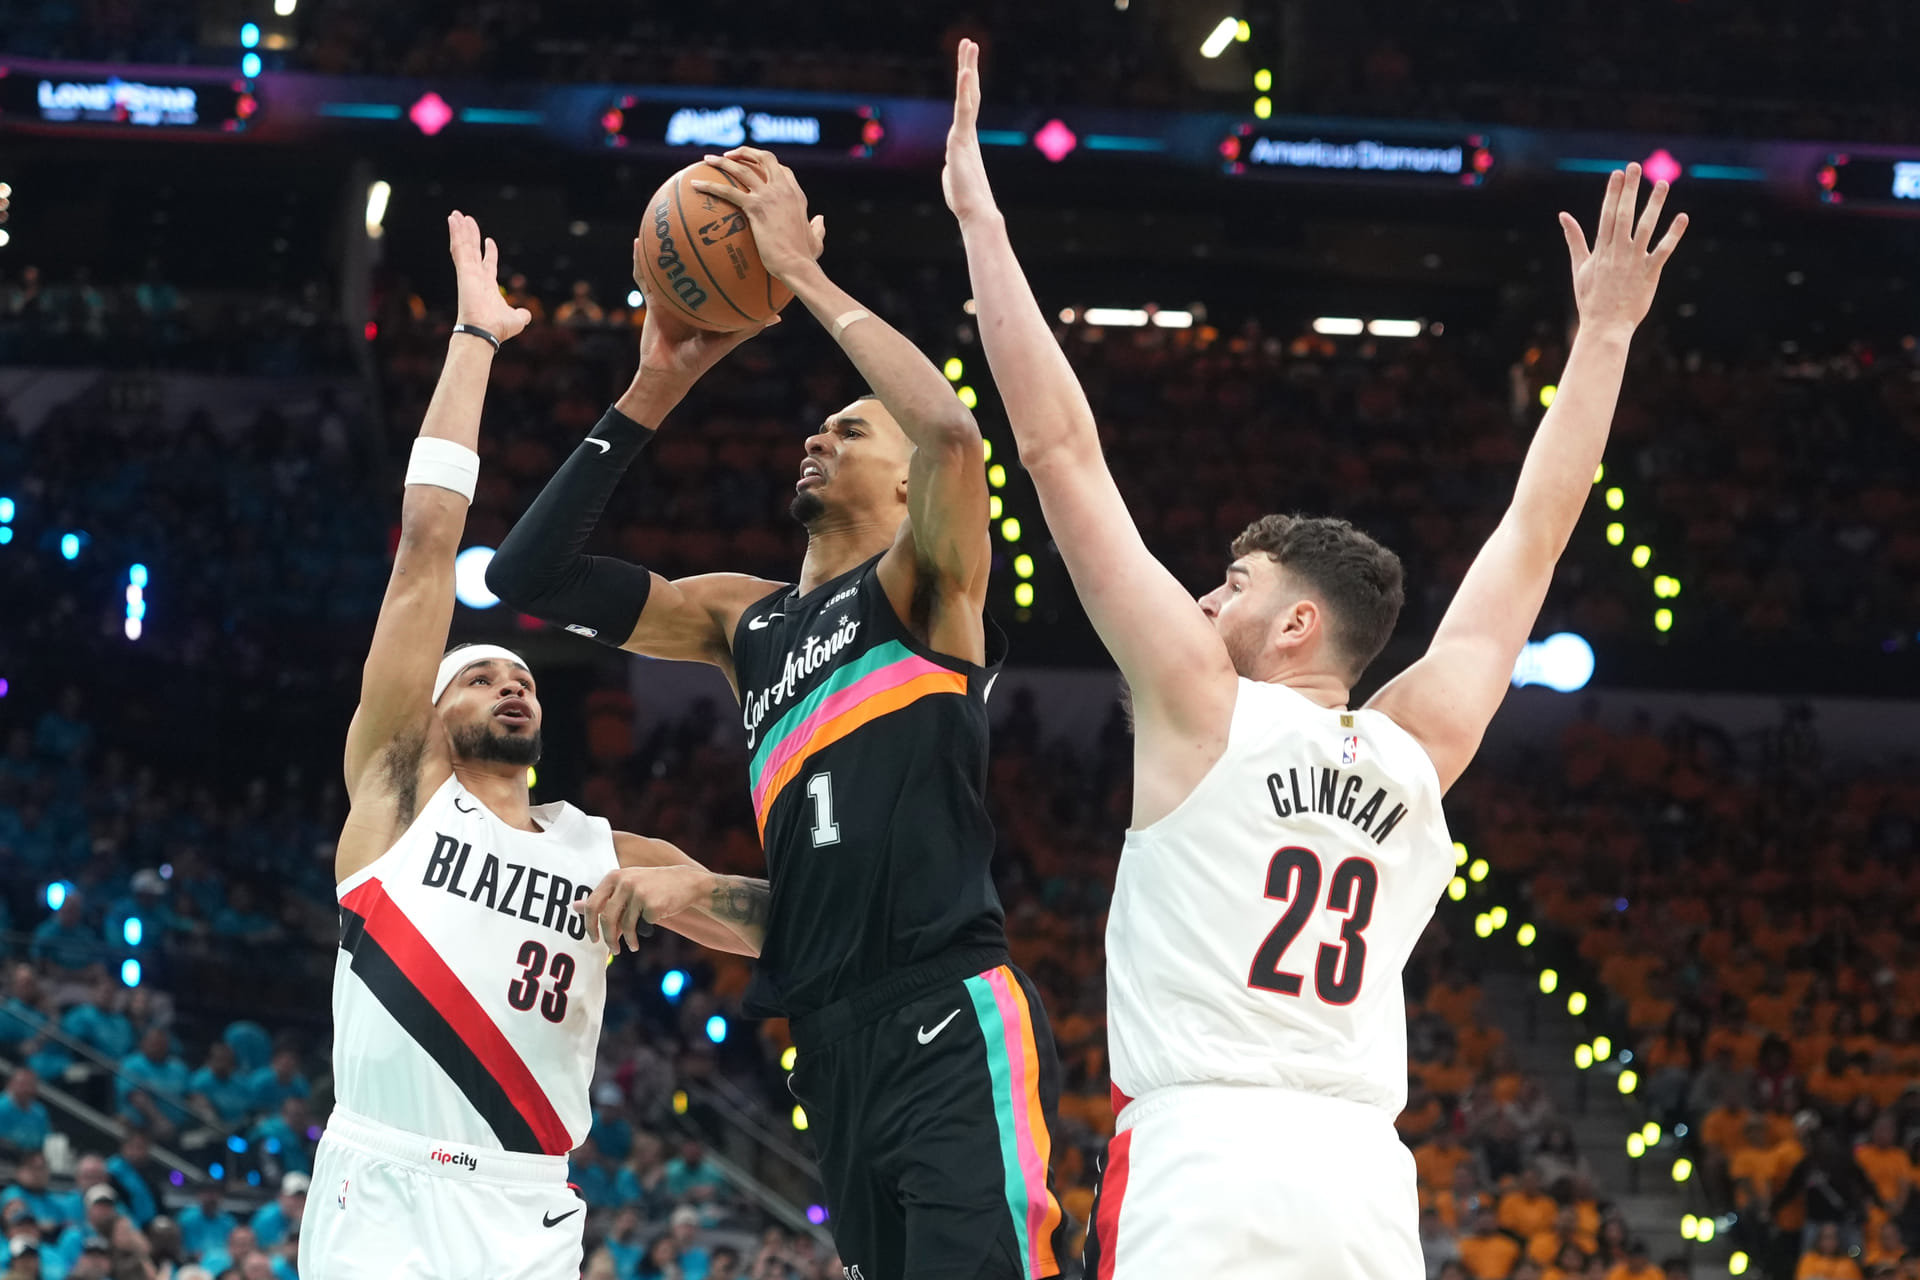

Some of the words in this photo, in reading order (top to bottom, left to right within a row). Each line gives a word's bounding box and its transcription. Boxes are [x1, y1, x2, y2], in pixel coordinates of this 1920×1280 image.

[1357, 141, 1463, 174] Diamond
[655, 198, 707, 311] Wilson
[743, 688, 770, 749] San
[770, 615, 860, 705] Antonio
[807, 771, 841, 848] 1
[1266, 766, 1408, 845] CLINGAN
[422, 831, 594, 941] BLAZERS
[1247, 845, 1379, 1006] 23
[507, 940, 576, 1023] 33
